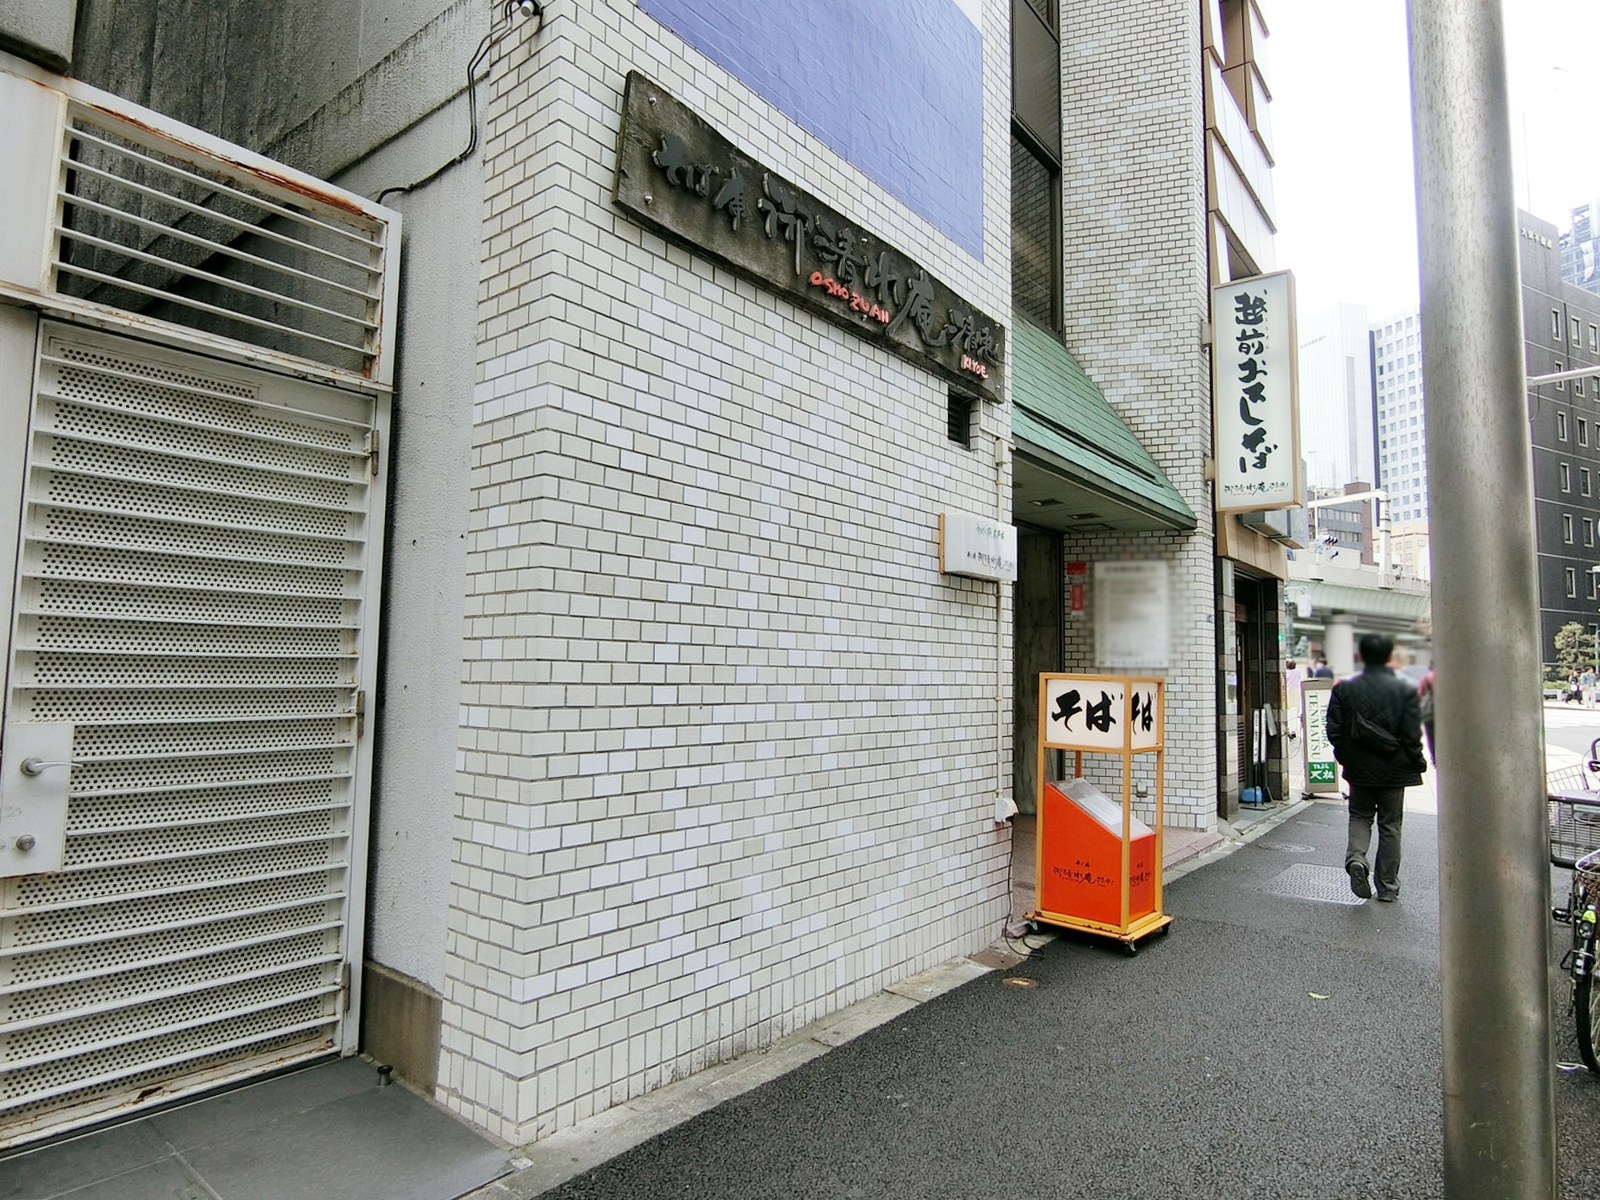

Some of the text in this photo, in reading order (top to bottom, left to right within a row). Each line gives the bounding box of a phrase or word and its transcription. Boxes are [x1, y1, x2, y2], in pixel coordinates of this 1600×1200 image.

[961, 354, 989, 379] KIYOE
[1052, 689, 1124, 733] そば
[1309, 692, 1321, 760] TENMATSU
